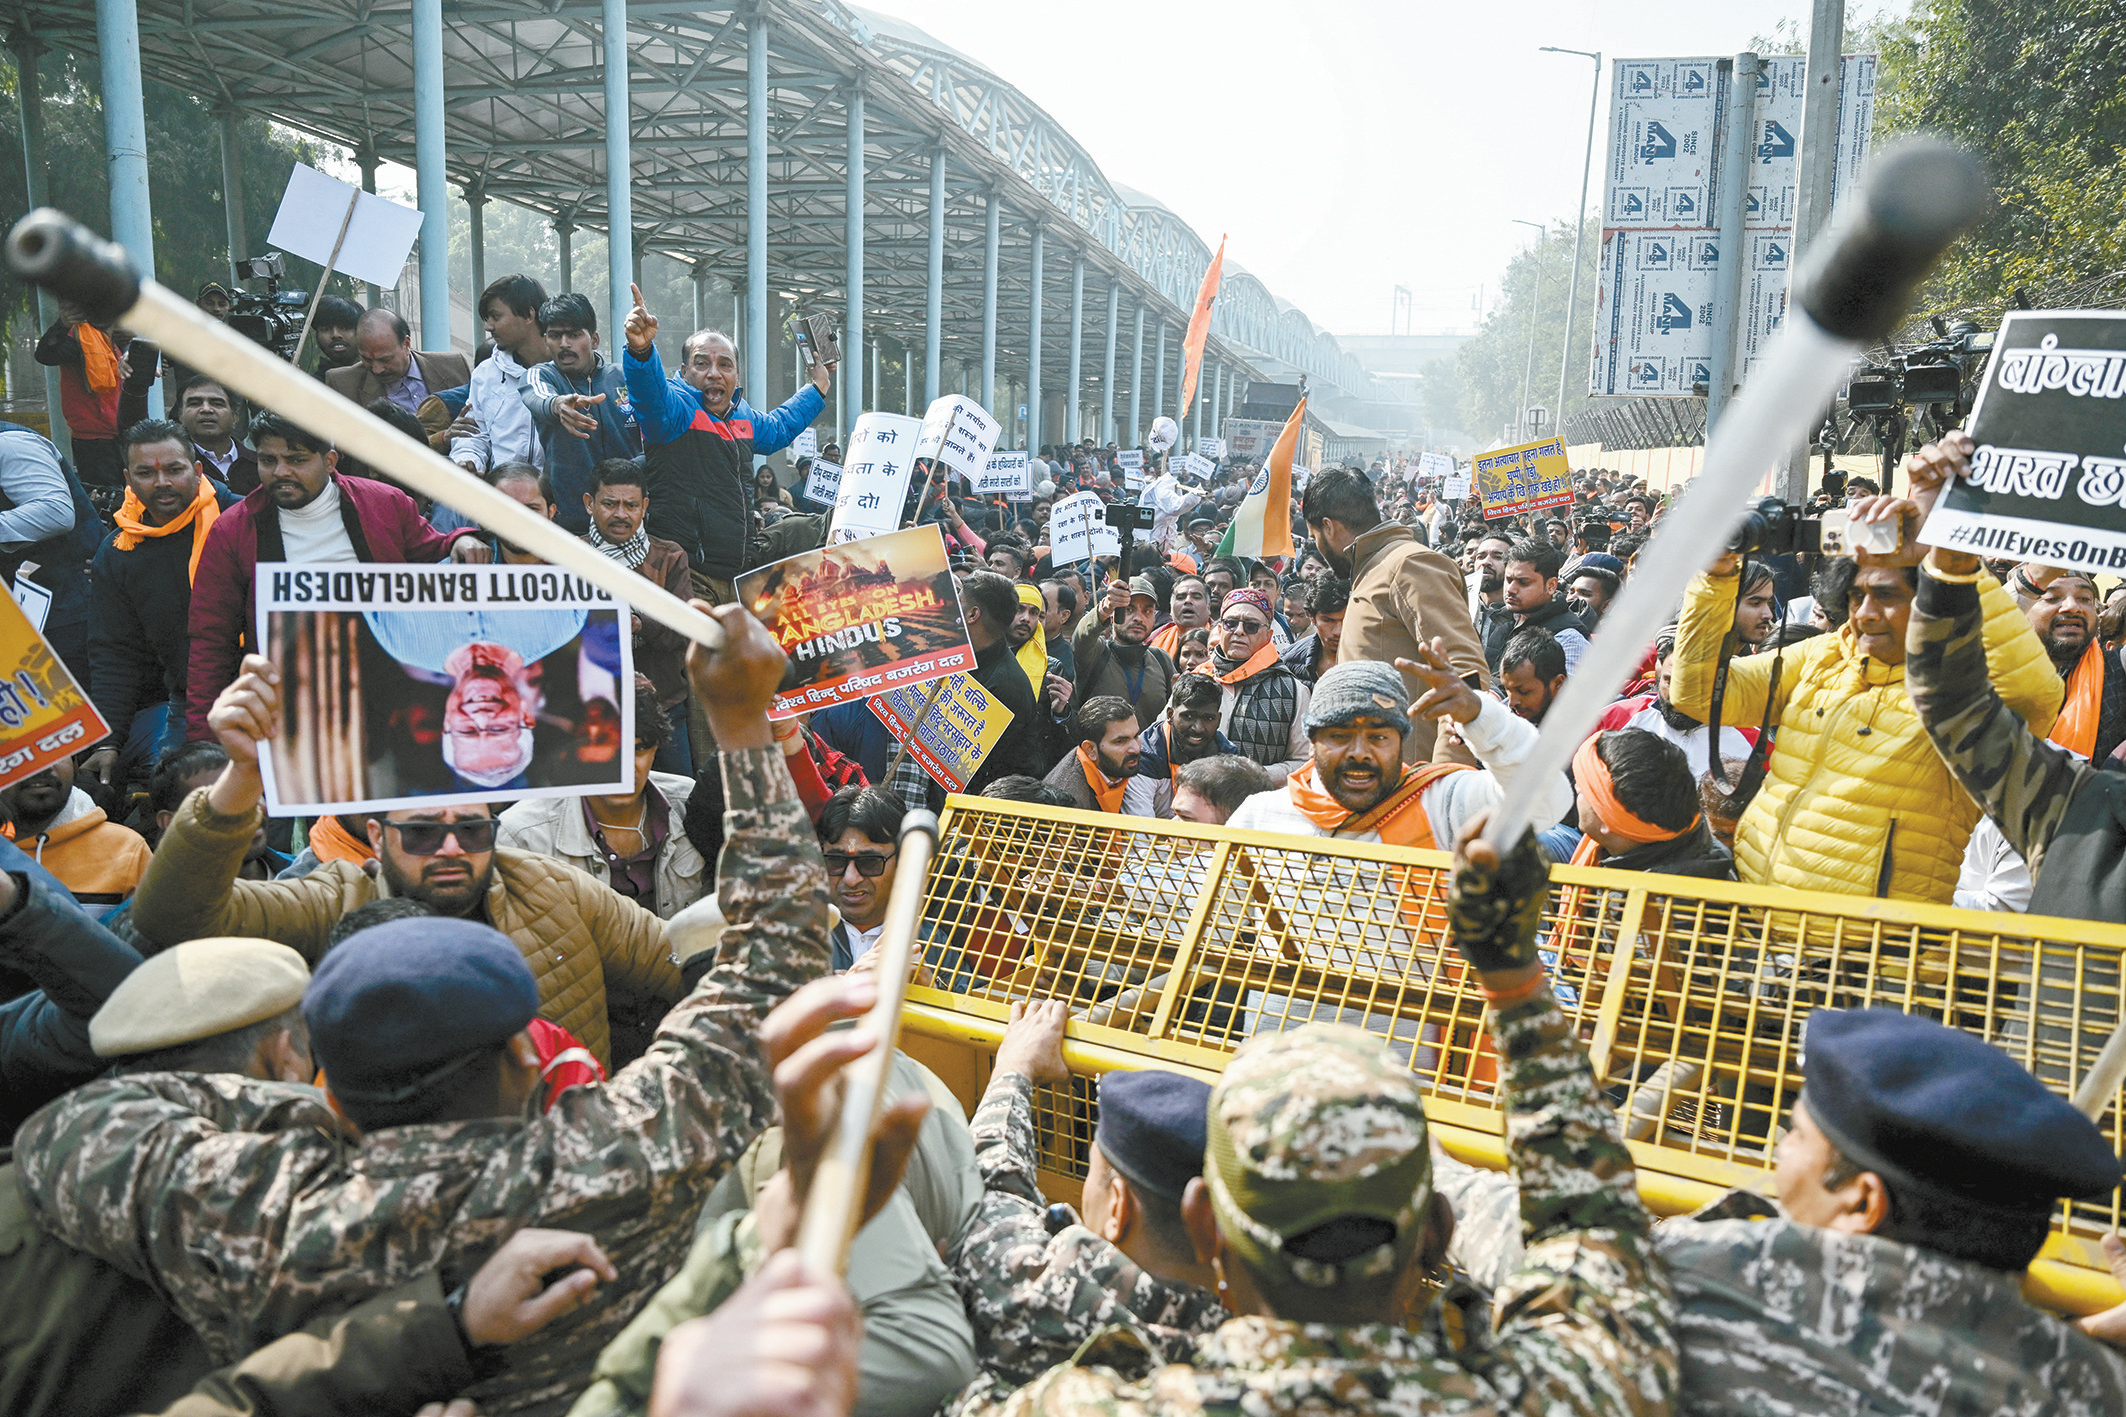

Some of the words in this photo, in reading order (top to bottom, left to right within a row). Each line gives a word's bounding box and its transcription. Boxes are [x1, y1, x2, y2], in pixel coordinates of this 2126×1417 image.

[1998, 333, 2126, 399] बांग्ला
[877, 429, 898, 444] को
[882, 461, 899, 476] के
[1477, 458, 1493, 471] इतना
[1494, 452, 1520, 467] अत्याचार
[1538, 444, 1555, 457] गलत
[1966, 444, 2079, 500] भारत
[857, 492, 880, 509] दो!
[1487, 489, 1507, 503] अन्याय
[1507, 484, 1515, 498] के
[272, 570, 478, 603] BANGLADESH
[778, 606, 812, 626] ALL
[818, 596, 857, 615] EYES
[872, 584, 899, 599] ON
[795, 617, 903, 662] HINDUS
[806, 685, 843, 703] हिन्दू
[838, 675, 883, 695] परिषद
[885, 660, 934, 681] बजरंग
[938, 653, 964, 667] दल
[928, 704, 944, 731] हिंदू
[943, 719, 973, 752] नरसंहार
[971, 743, 982, 760] के
[940, 689, 953, 707] की
[950, 701, 977, 729] जरूरत
[974, 720, 985, 737] है
[35, 719, 85, 752] दल
[922, 750, 945, 778] बजरंग
[944, 776, 959, 791] दल
